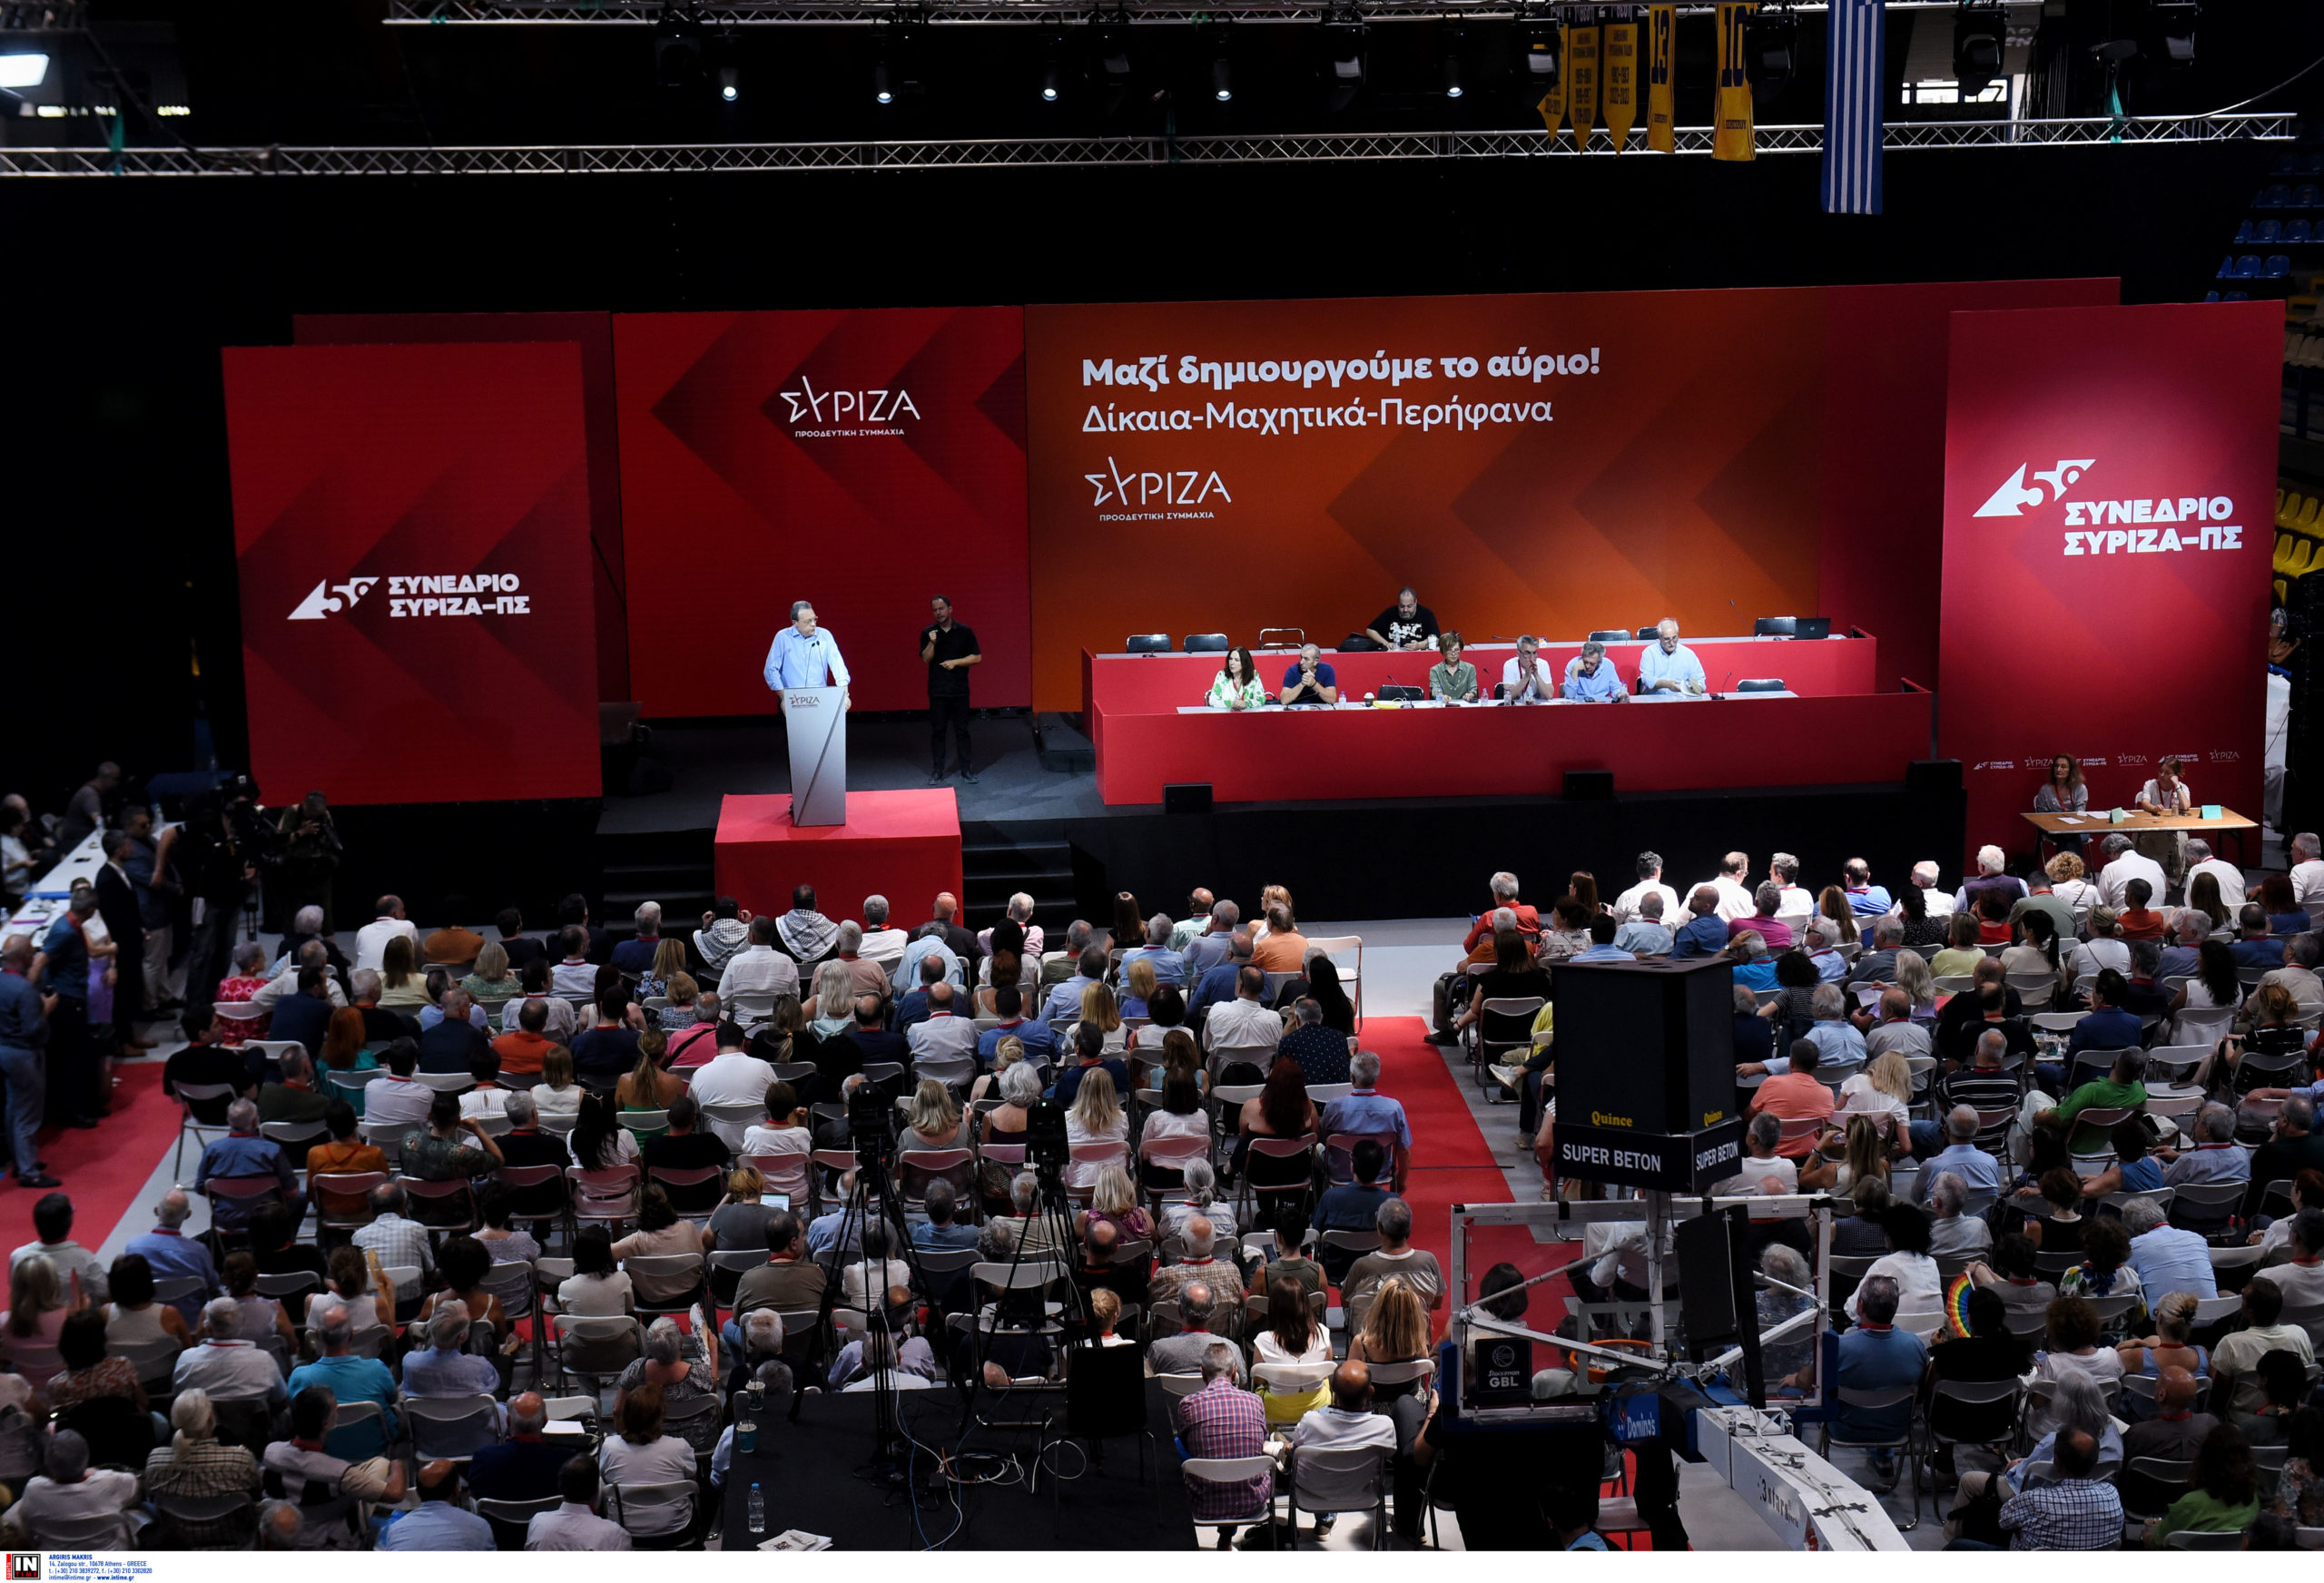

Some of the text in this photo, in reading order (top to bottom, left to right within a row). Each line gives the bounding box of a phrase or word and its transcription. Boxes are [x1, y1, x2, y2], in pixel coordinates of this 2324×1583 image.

[1651, 10, 1669, 84] 13
[1082, 347, 1600, 392] Μαζί δημιουργούμε το αύριο!
[780, 375, 921, 423] ΣΥΡΙΖΑ
[1082, 395, 1553, 436] Δίκαια-Μαχητικά-Περήφανα
[795, 428, 905, 438] ΠΡΟΟΔΕΥΤΙΚΗ ΣΥΜΜΑΧΙΑ
[1084, 456, 1232, 506] ΣΥΡΙΖΑ
[1099, 511, 1215, 522] ΠΡΟΟΔΕΥΤΙΚΗ ΣΥΜΜΑΧΙΑ
[2064, 496, 2233, 526] ΣΥΝΕΔΡΙΟ
[2063, 526, 2243, 556] ΣΥΡΙΖΑ-ΠΣ
[388, 573, 520, 595] ΣΥΝΕΔΡΙΟ
[389, 595, 531, 618] ΣΥΡΙΖΑ-ΠΣ
[1591, 1111, 1633, 1127] Quince
[1704, 1110, 1723, 1127] Quince
[1562, 1143, 1661, 1173] SUPER BETON
[1696, 1140, 1738, 1171] SUPER BETON
[1489, 1377, 1519, 1388] GBL
[1627, 1411, 1657, 1440] Domino's
